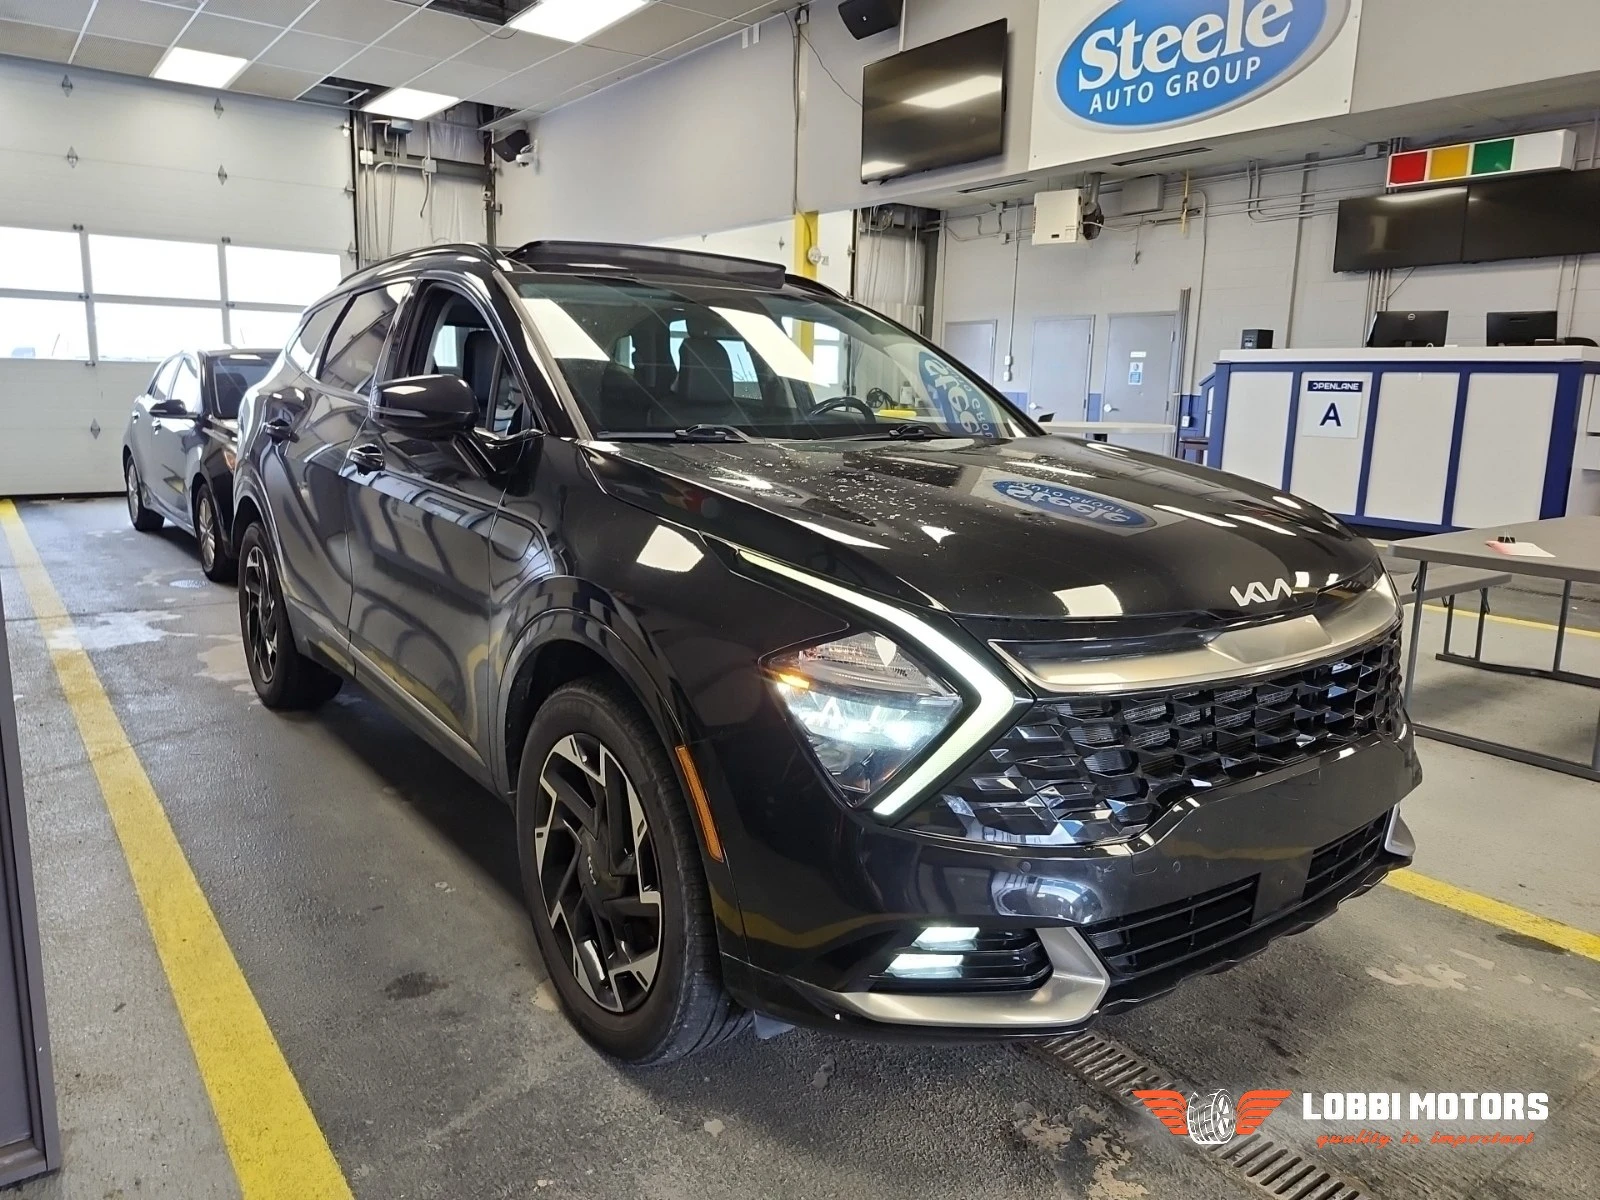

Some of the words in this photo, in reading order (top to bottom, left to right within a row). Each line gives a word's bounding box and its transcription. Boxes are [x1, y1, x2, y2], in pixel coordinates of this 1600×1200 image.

[1078, 0, 1294, 93] Steele
[1089, 81, 1154, 115] AUTO
[1165, 56, 1262, 97] GROUP
[1312, 382, 1360, 391] OPENLANE
[1319, 402, 1342, 427] A
[1229, 578, 1292, 607] KIA
